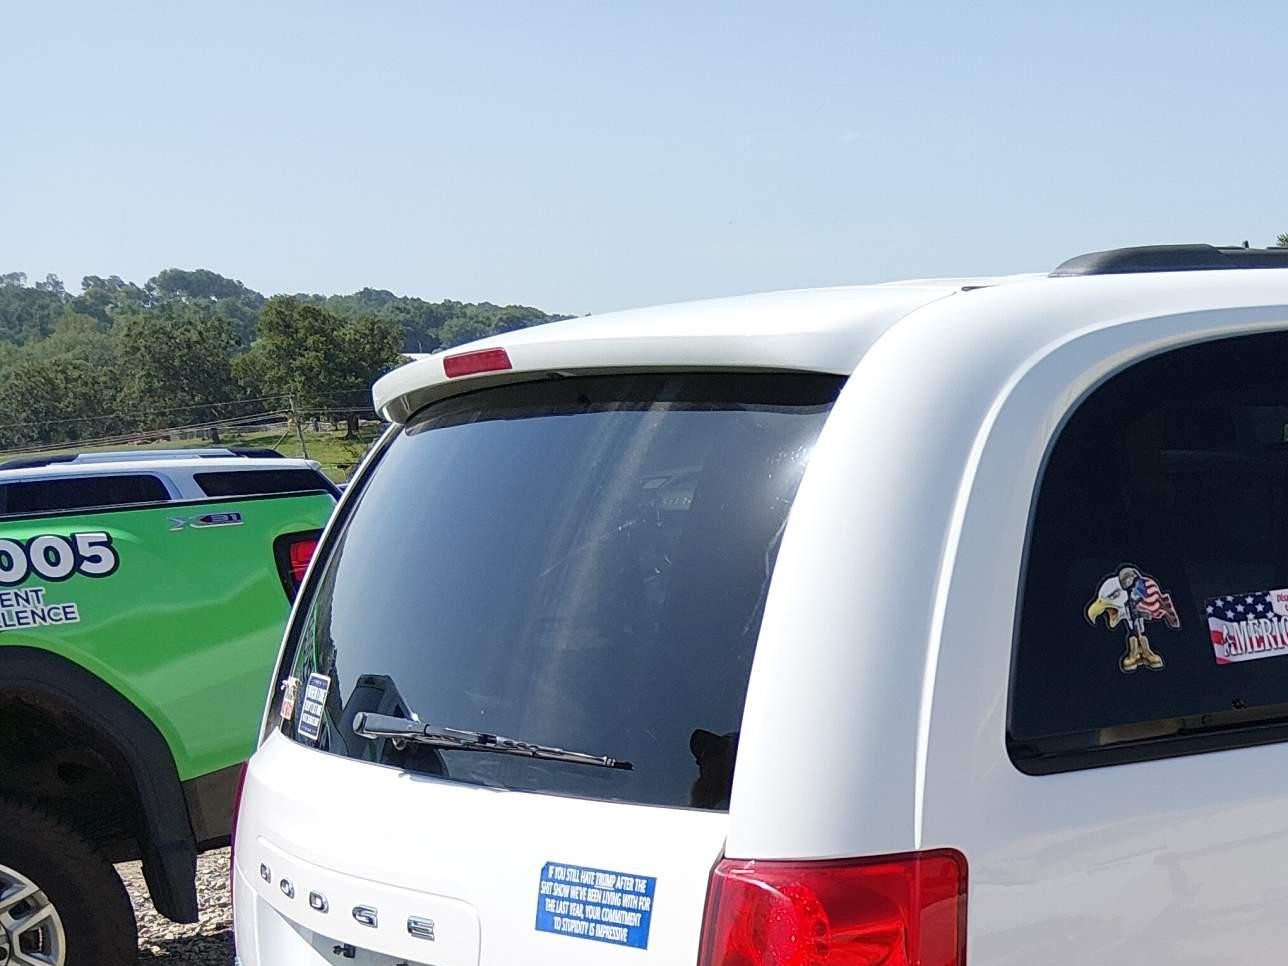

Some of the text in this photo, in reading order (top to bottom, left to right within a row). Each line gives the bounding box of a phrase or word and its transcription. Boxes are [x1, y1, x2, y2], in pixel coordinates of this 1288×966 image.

[0, 604, 78, 628] LENCE
[554, 866, 566, 880] YOU
[566, 868, 580, 882] STILL
[581, 870, 596, 886] HATE
[595, 872, 616, 890] TRUMP
[616, 875, 634, 891] AFTER
[635, 878, 647, 894] THE
[259, 861, 435, 942] DODGE
[540, 881, 651, 911] SHIT SHOW WE'VE BEEN LIVING WITH FOR
[545, 897, 642, 928] THE LAST YEAR, YOUR COMMITMENT
[554, 916, 628, 942] TO STUPIDITY IS IMPRESSIVE
